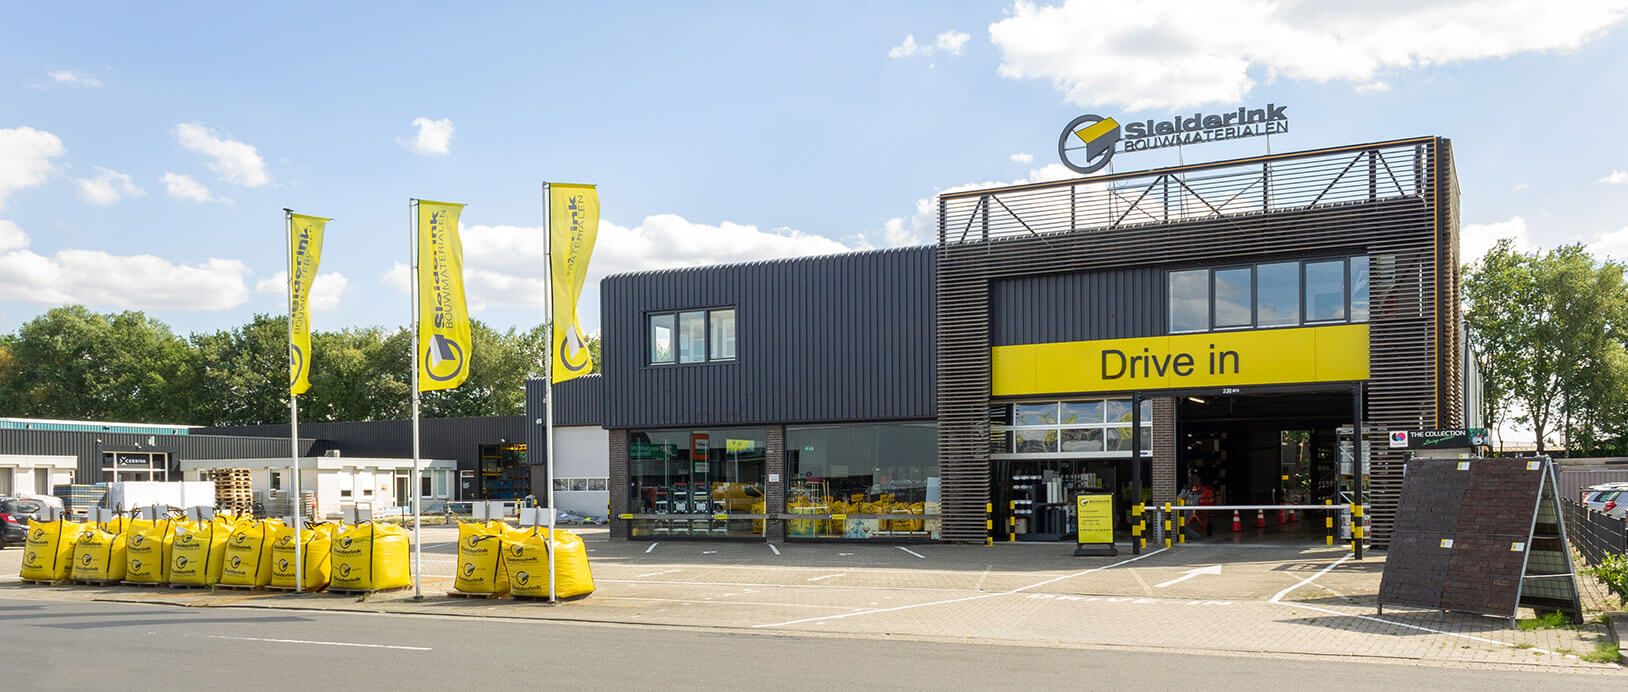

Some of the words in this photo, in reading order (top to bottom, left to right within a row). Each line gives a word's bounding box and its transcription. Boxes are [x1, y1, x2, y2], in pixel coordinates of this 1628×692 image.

[1125, 103, 1288, 139] Sleiderink
[1125, 120, 1289, 152] BOUWMATERIALEN
[292, 226, 309, 331] eiderink
[437, 209, 454, 329] BOUWMATERIALEN
[1101, 347, 1194, 380] Drive
[1209, 343, 1239, 375] in
[1424, 430, 1466, 438] COLLECTION
